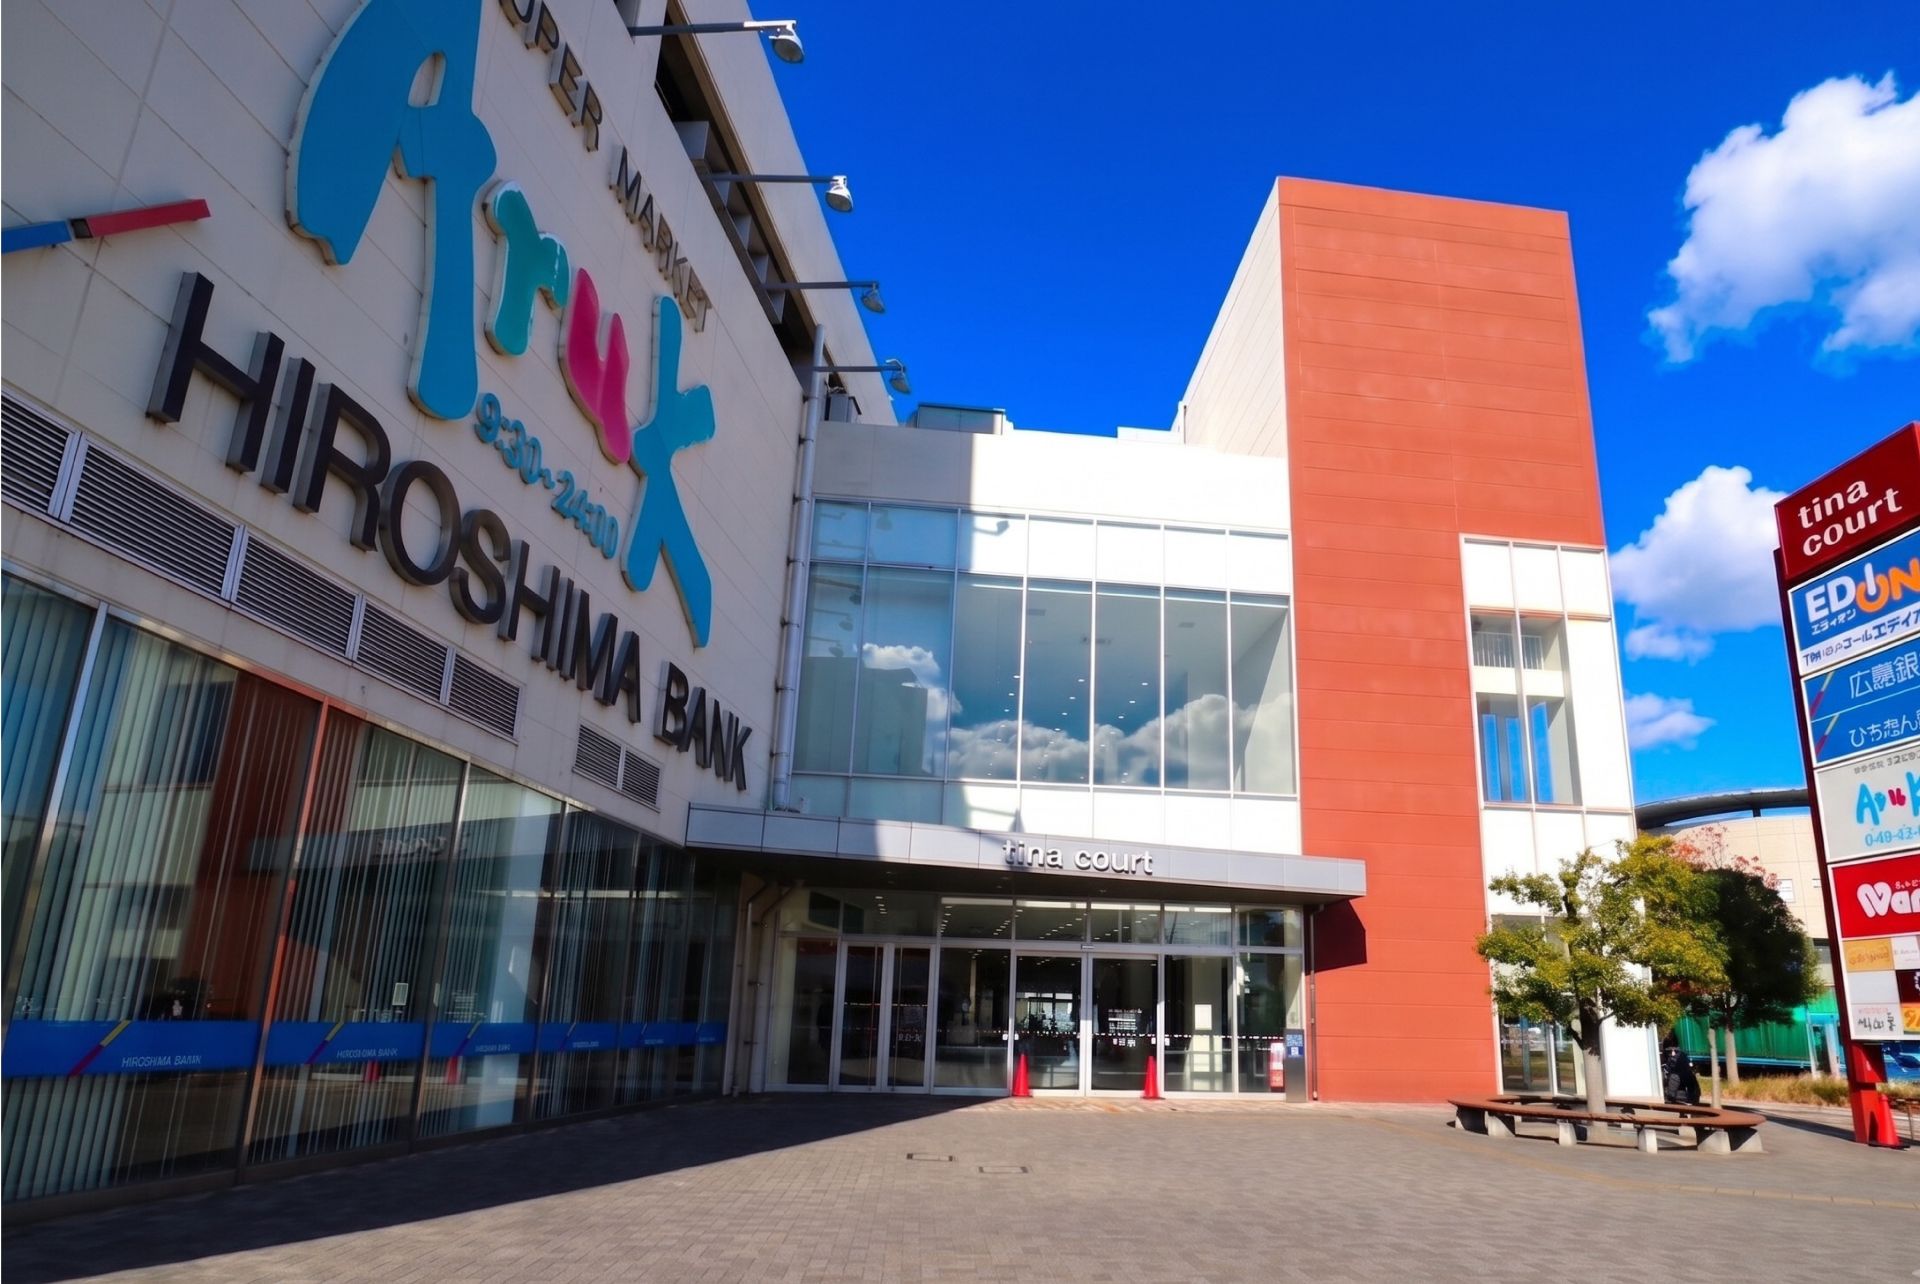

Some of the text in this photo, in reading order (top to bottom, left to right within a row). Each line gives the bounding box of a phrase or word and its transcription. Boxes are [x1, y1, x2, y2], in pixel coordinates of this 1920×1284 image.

[146, 271, 753, 791] HIROSHIMA BANK
[1798, 479, 1870, 530] tina
[1802, 487, 1903, 558] court
[1002, 839, 1153, 876] tina court
